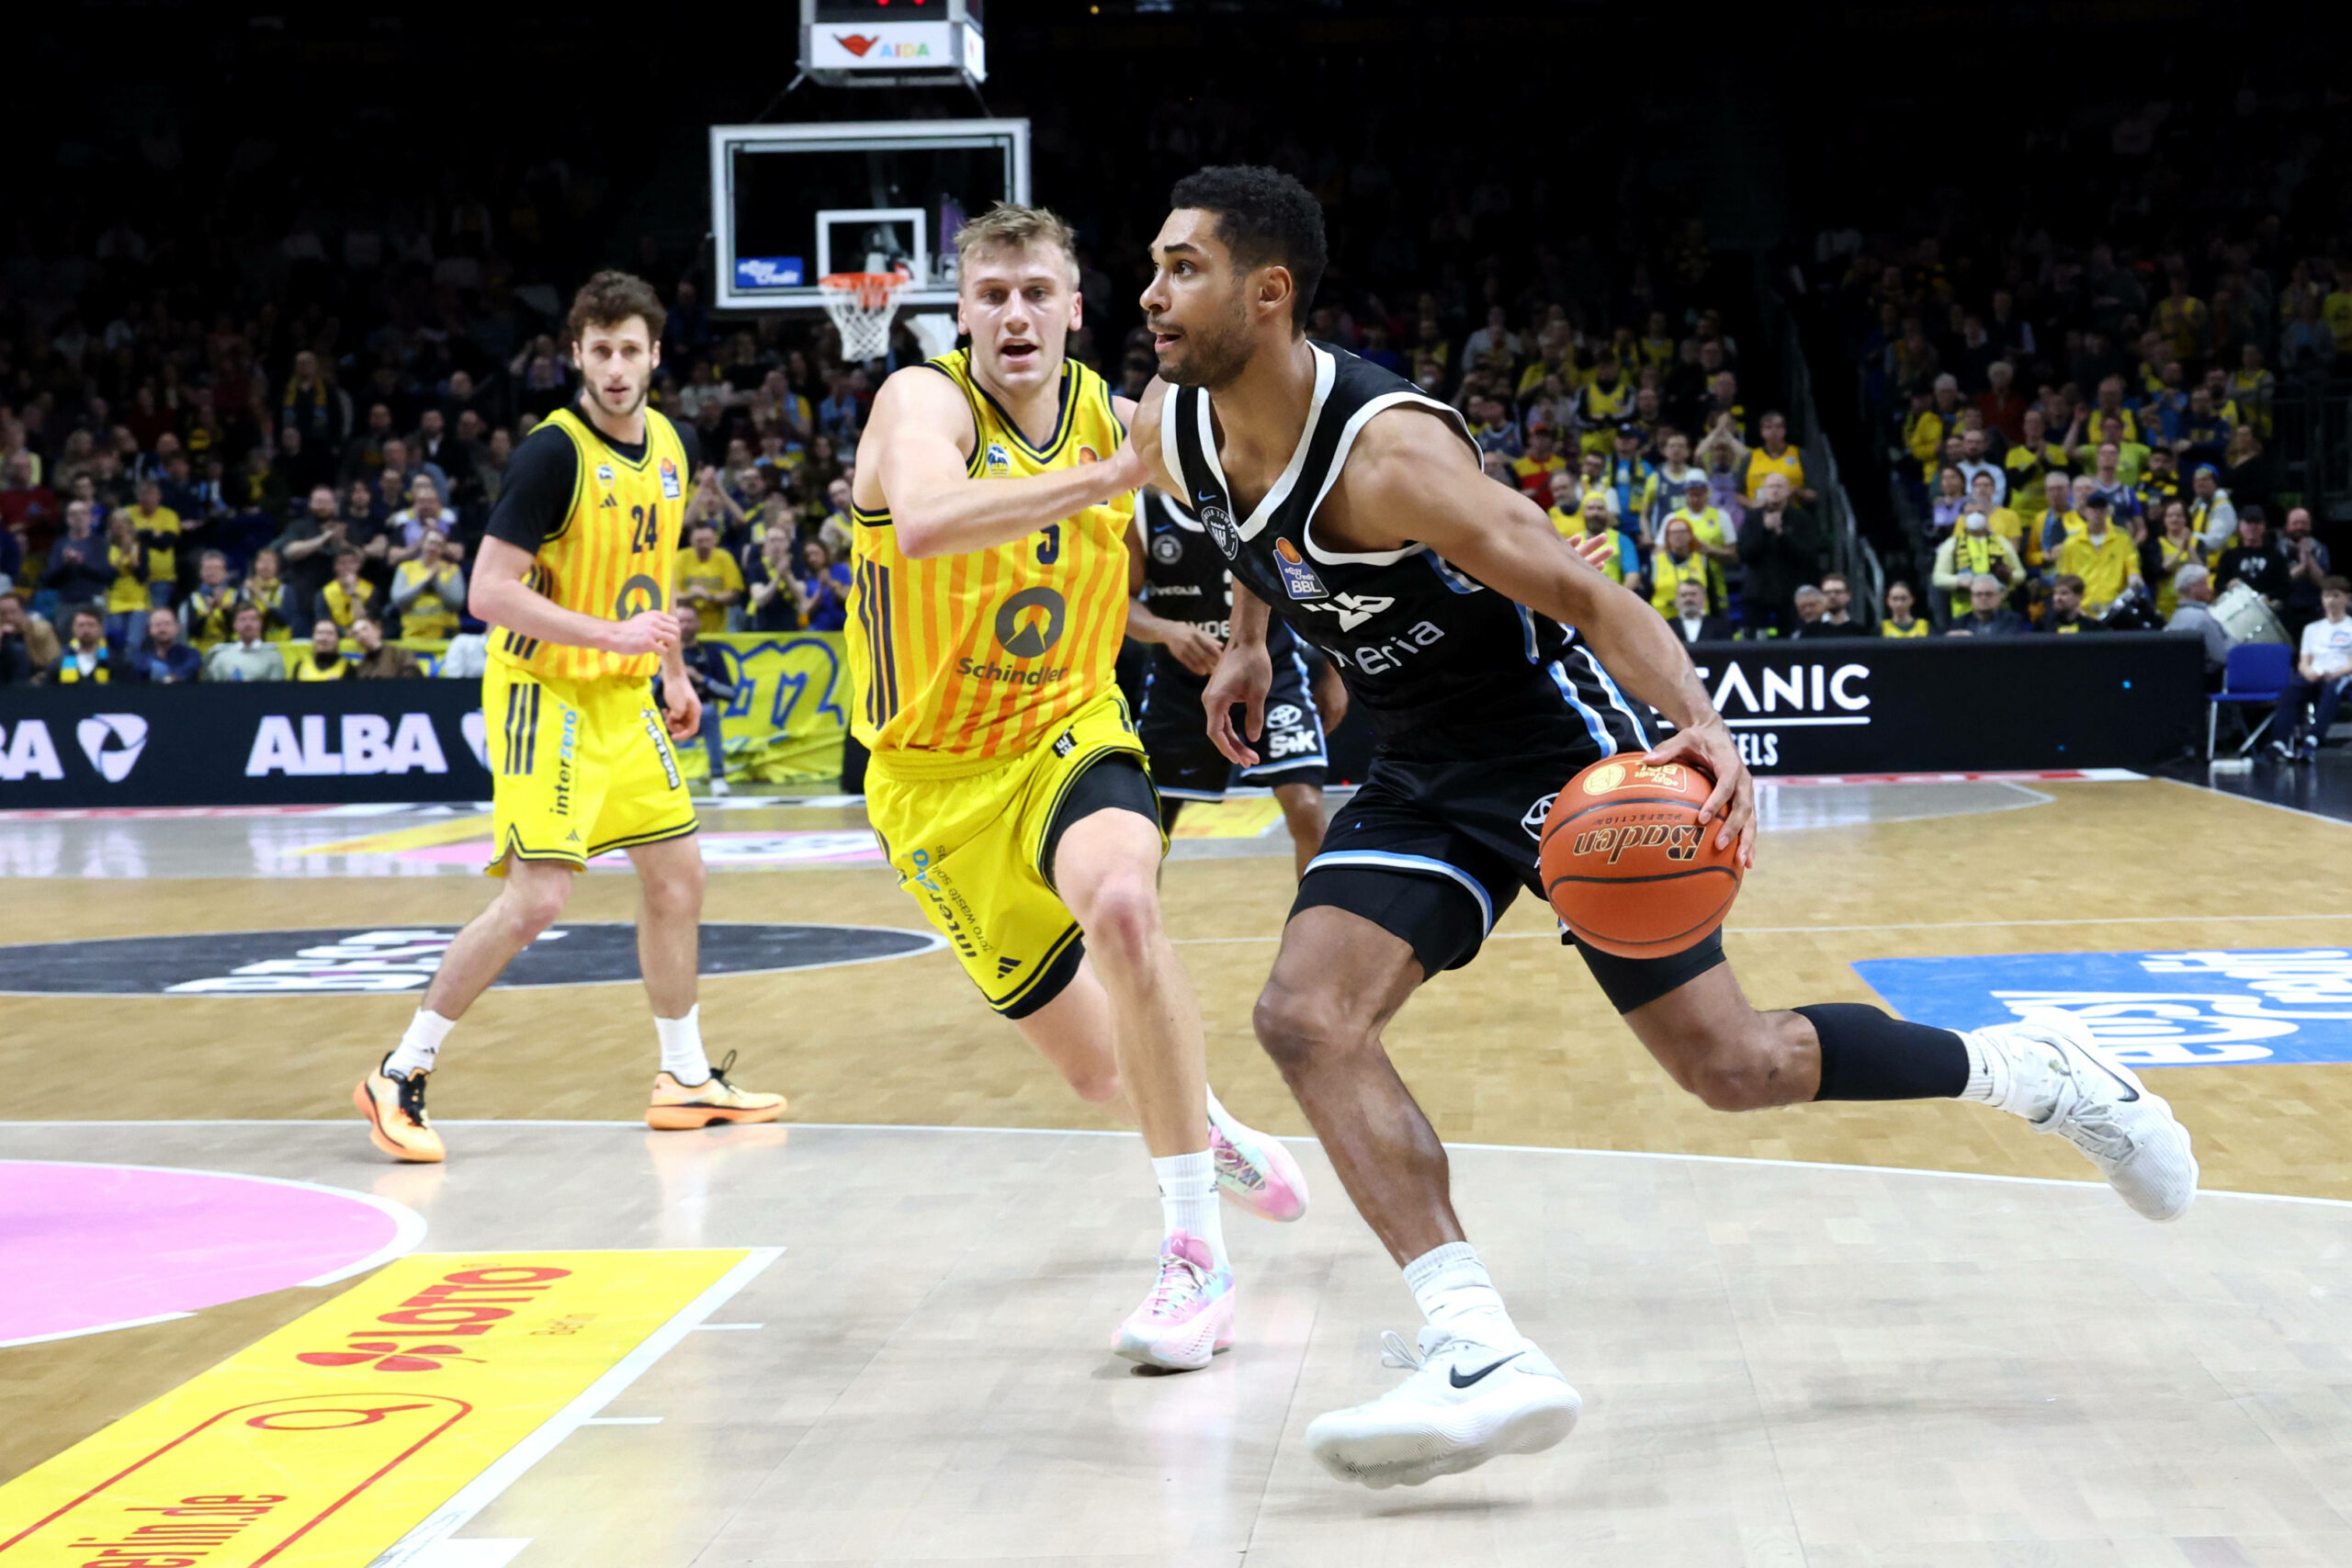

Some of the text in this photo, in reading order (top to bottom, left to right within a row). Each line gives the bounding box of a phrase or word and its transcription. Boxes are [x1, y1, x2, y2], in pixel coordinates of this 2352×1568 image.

[879, 43, 930, 58] AIDA
[631, 503, 658, 554] 24
[1291, 580, 1321, 593] BBL
[956, 657, 1069, 685] Schindler
[1320, 621, 1445, 675] eria
[1695, 661, 1871, 713] ANIC
[245, 713, 448, 776] ALBA
[549, 709, 578, 816] interzero
[1731, 732, 1779, 766] ELS
[1596, 814, 1683, 825] PERFECTION
[1572, 824, 1707, 865] Baden
[913, 849, 978, 958] interzo
[949, 888, 976, 925] waste
[346, 1267, 573, 1337] LOTTO
